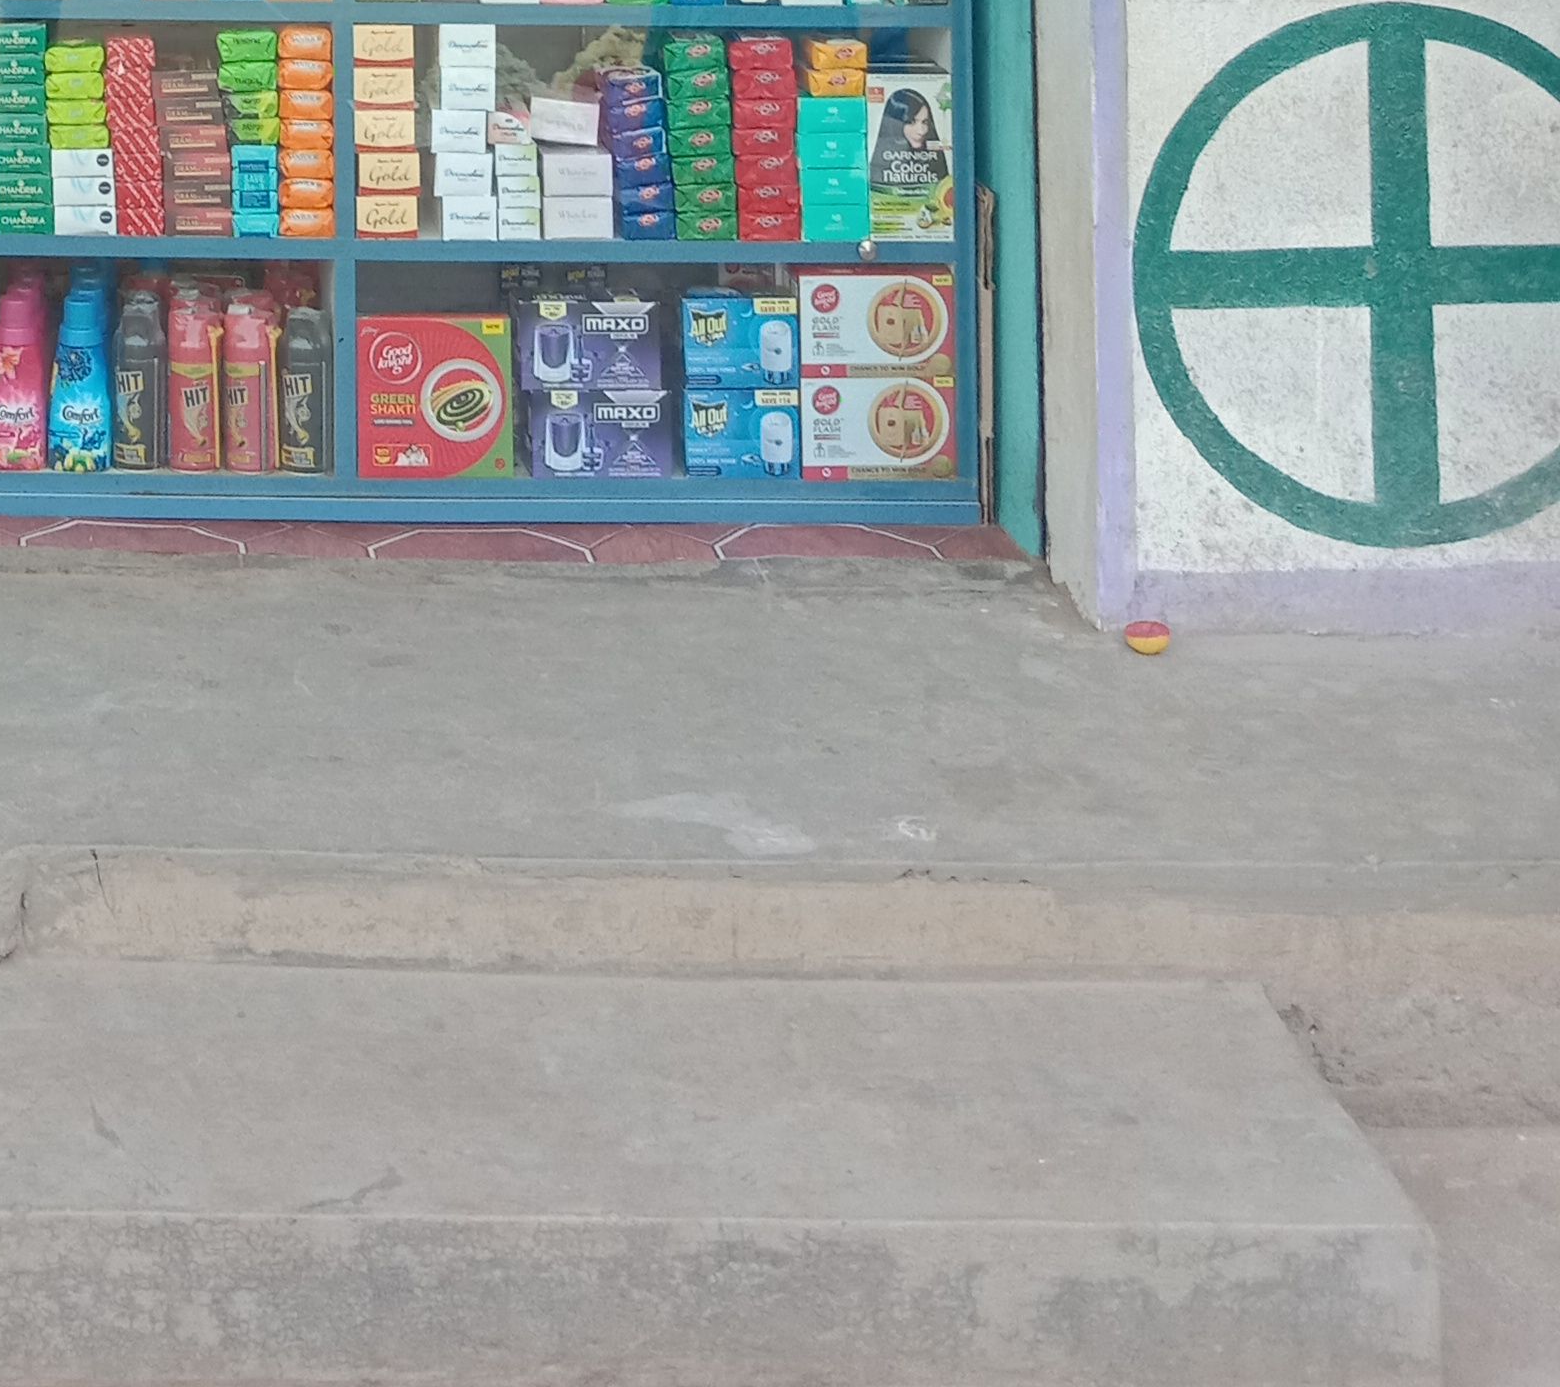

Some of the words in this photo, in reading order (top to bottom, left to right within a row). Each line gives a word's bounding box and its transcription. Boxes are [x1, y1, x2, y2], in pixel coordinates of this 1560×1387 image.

[890, 161, 930, 174] Color
[366, 207, 408, 228] Gold
[382, 342, 413, 359] Good
[115, 372, 142, 394] HIT
[283, 375, 311, 396] HIT
[183, 386, 210, 408] HIT
[370, 393, 416, 405] GREEN
[370, 404, 417, 415] SHAKTI
